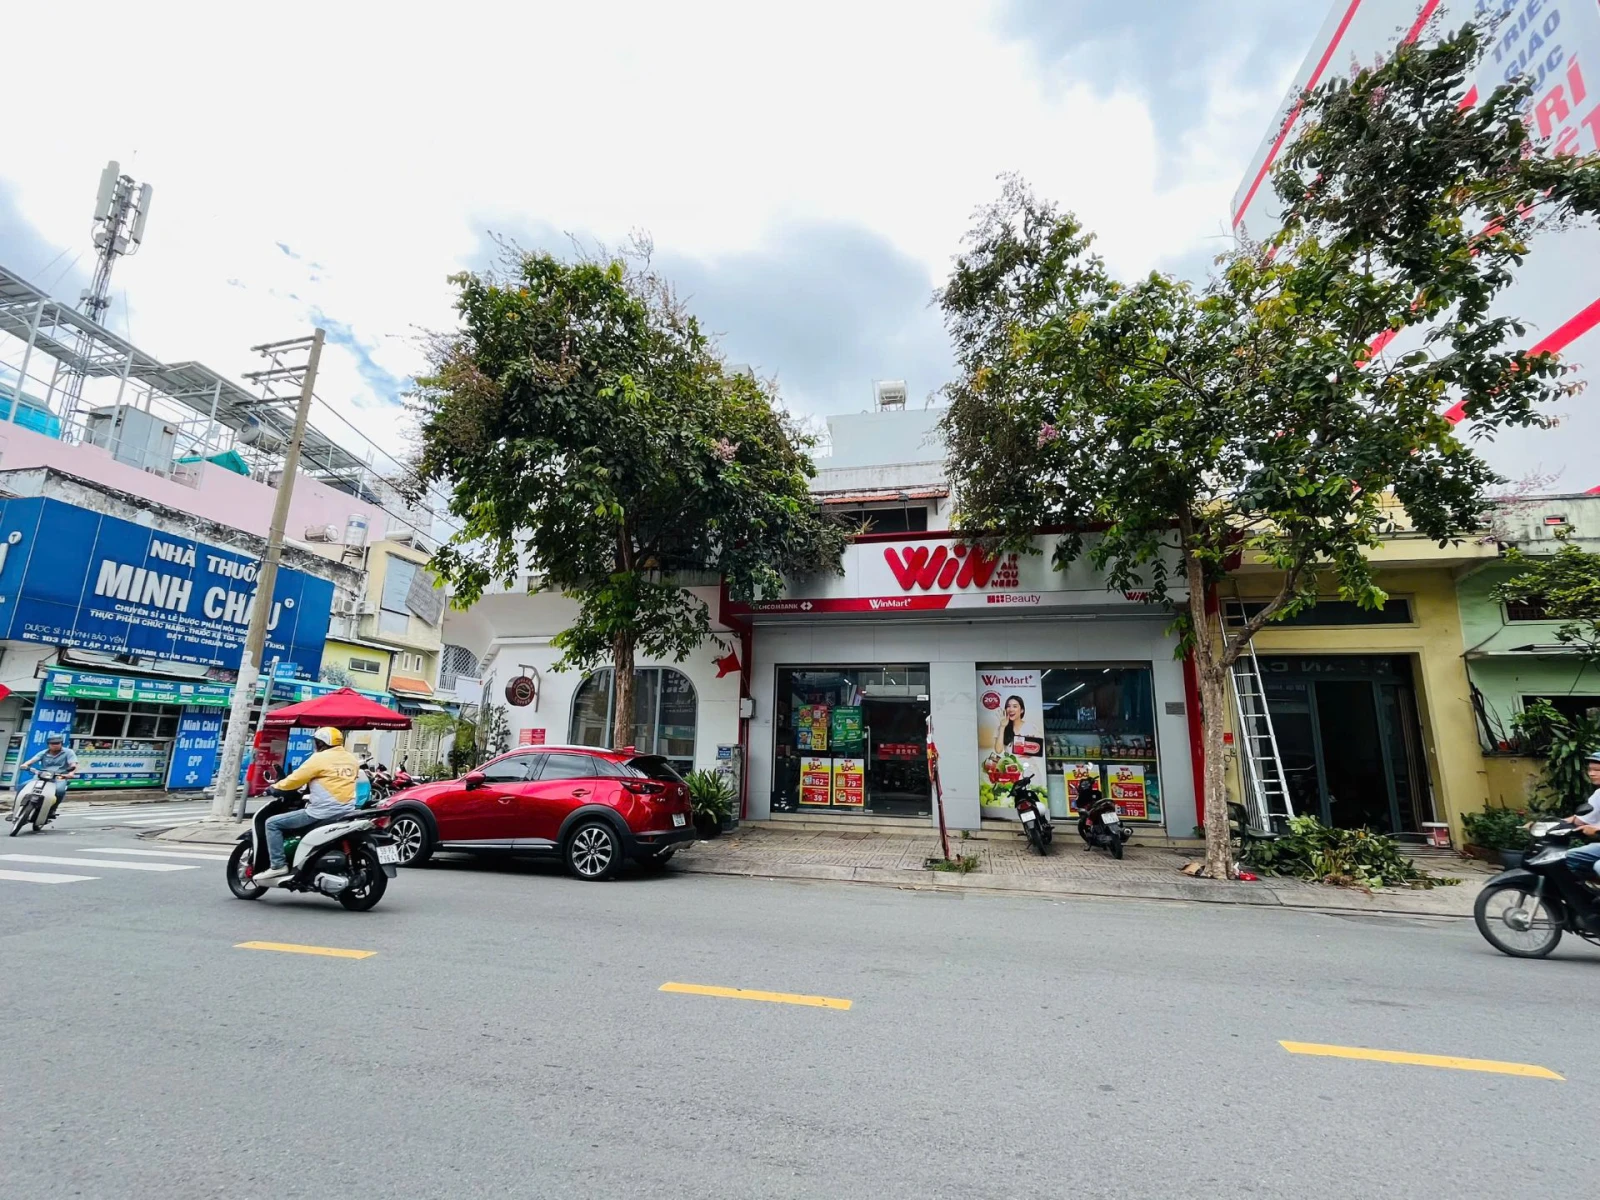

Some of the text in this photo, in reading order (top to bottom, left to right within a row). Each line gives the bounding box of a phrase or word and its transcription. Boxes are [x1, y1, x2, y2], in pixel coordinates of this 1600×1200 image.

[150, 540, 262, 583] NHÀ THUỐ
[94, 560, 193, 613] MINH
[991, 580, 1019, 588] NEED
[1005, 594, 1040, 604] Beauty
[90, 610, 114, 622] THỰC
[116, 612, 140, 626] PHẨM
[142, 618, 164, 630] CHỨC
[115, 604, 148, 617] CHUYÊN
[180, 616, 200, 627] DƯỢC
[182, 720, 200, 730] Minh
[188, 755, 202, 767] GPP
